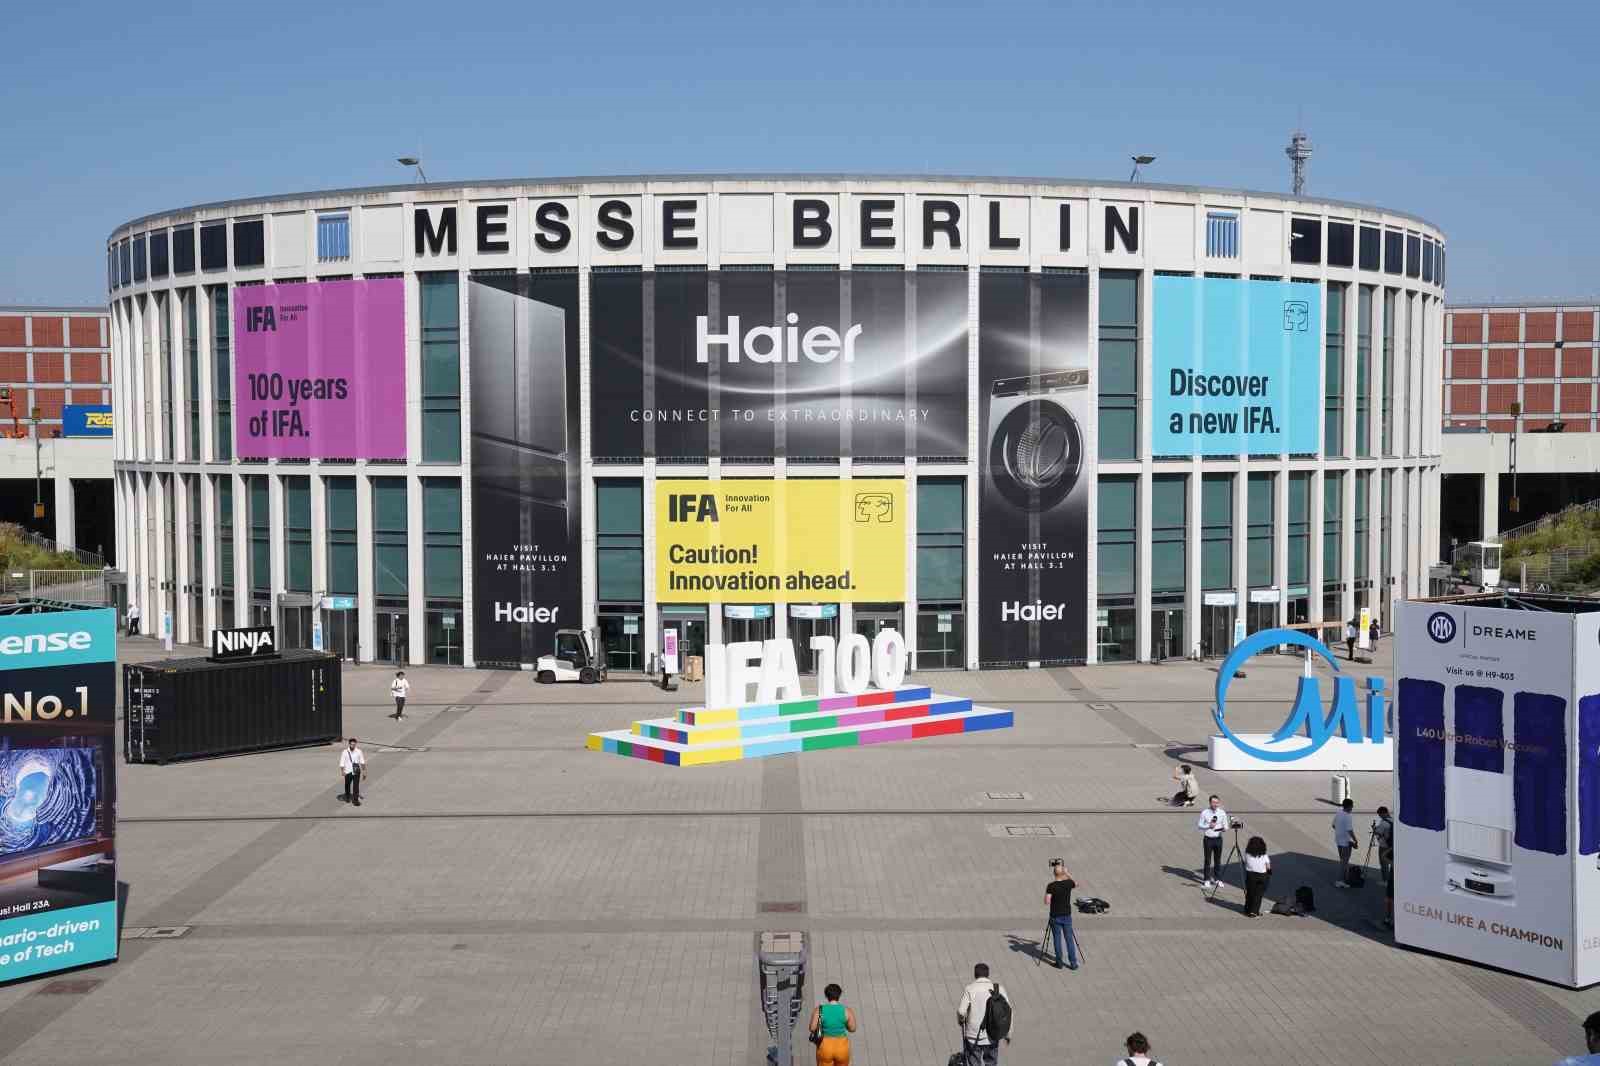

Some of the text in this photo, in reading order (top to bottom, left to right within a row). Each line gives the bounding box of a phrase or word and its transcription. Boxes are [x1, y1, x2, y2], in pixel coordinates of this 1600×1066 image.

[413, 199, 1139, 257] MESSE BERLIN
[246, 305, 277, 332] IFA
[695, 312, 863, 364] Haier
[248, 372, 348, 407] 100 years
[1169, 368, 1269, 397] Discover
[249, 409, 310, 437] of IFA.
[630, 408, 930, 422] CONNECT TO EXTRAORDINARY
[1169, 406, 1281, 434] a new IFA.
[668, 494, 720, 523] IFA
[725, 494, 770, 503] Innovation
[725, 503, 753, 512] For All
[486, 553, 568, 562] HAIER PAVILLON
[513, 544, 540, 552] VISIT
[668, 544, 758, 565] Caution!
[993, 552, 1075, 561] HAIER PAVILLON
[1021, 543, 1048, 551] VISIT
[496, 563, 557, 572] AT HALL 3.1
[1004, 562, 1016, 570] AT
[1020, 562, 1045, 570] HALL
[669, 570, 857, 591] Innovation ahead.
[495, 601, 560, 624] Haier
[1001, 599, 1066, 622] Haier
[0, 631, 92, 655] ense
[217, 630, 273, 656] NINJA
[1472, 625, 1537, 641] DREAME
[705, 628, 906, 709] IFA 100
[1446, 665, 1463, 675] Visit
[1465, 669, 1474, 677] us
[3, 686, 89, 722] No.1
[1416, 727, 1436, 739] L40
[12, 902, 31, 913] Hall
[32, 899, 50, 910] 23A
[1403, 902, 1564, 952] CLEAN LIKE A CHAMPION
[14, 945, 33, 962] of
[35, 939, 75, 959] Tech
